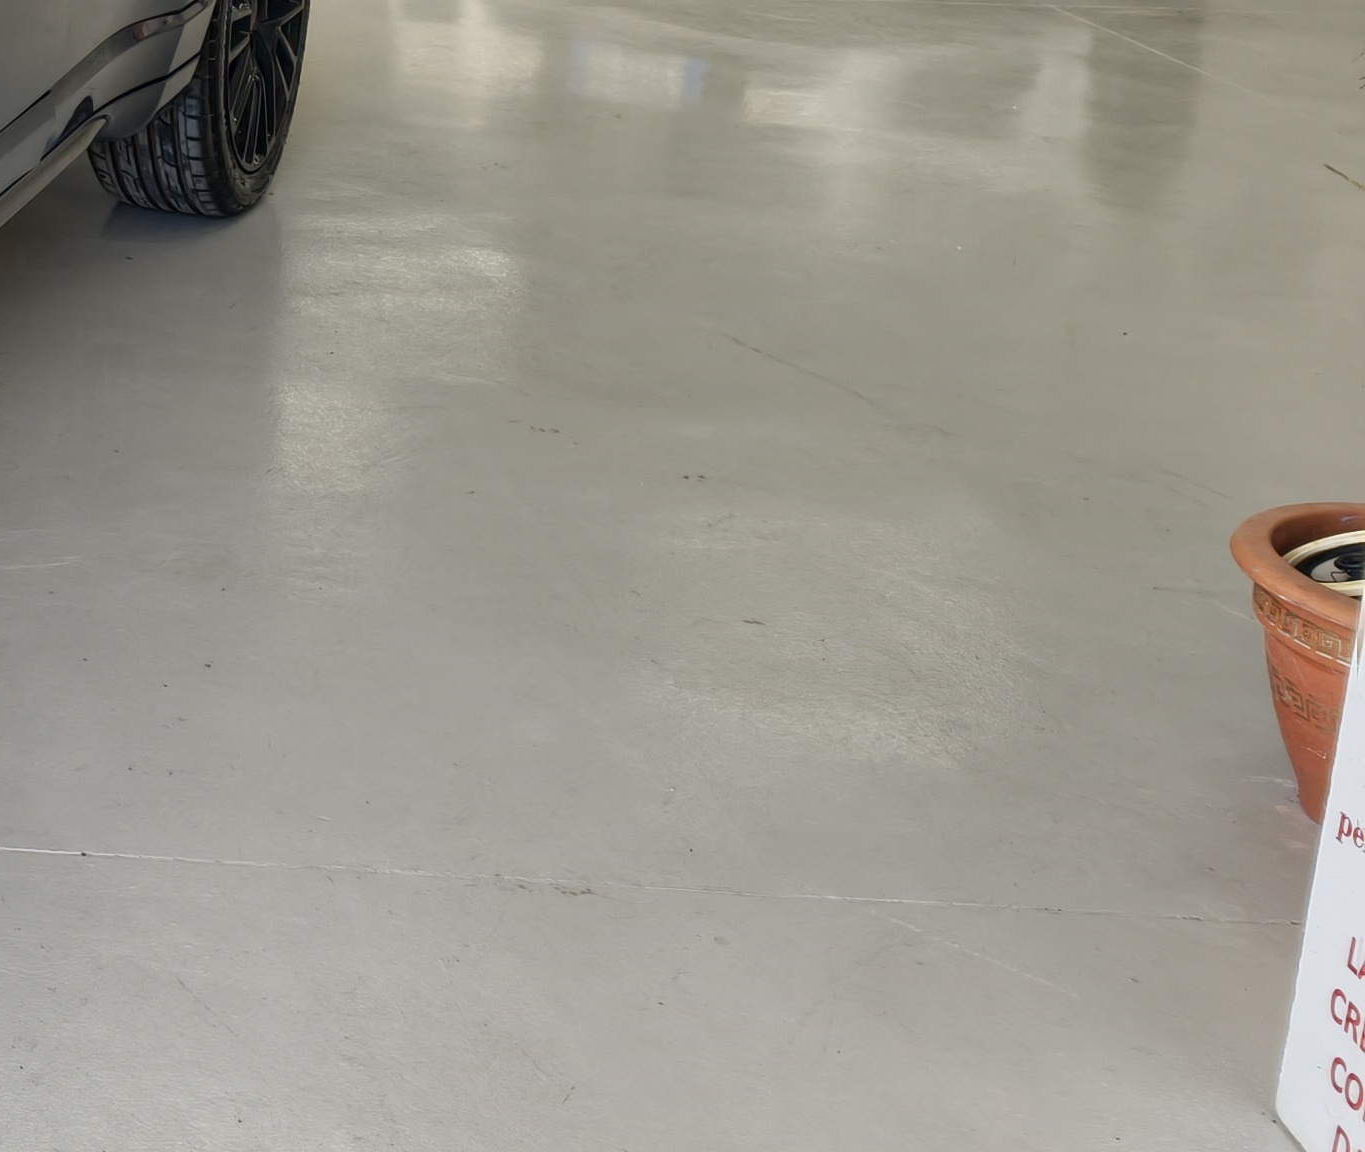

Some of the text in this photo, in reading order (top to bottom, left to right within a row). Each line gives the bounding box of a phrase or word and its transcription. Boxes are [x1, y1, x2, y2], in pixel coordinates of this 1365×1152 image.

[1335, 810, 1365, 854] pe
[1330, 988, 1365, 1055] CR
[1330, 1056, 1365, 1123] CO
